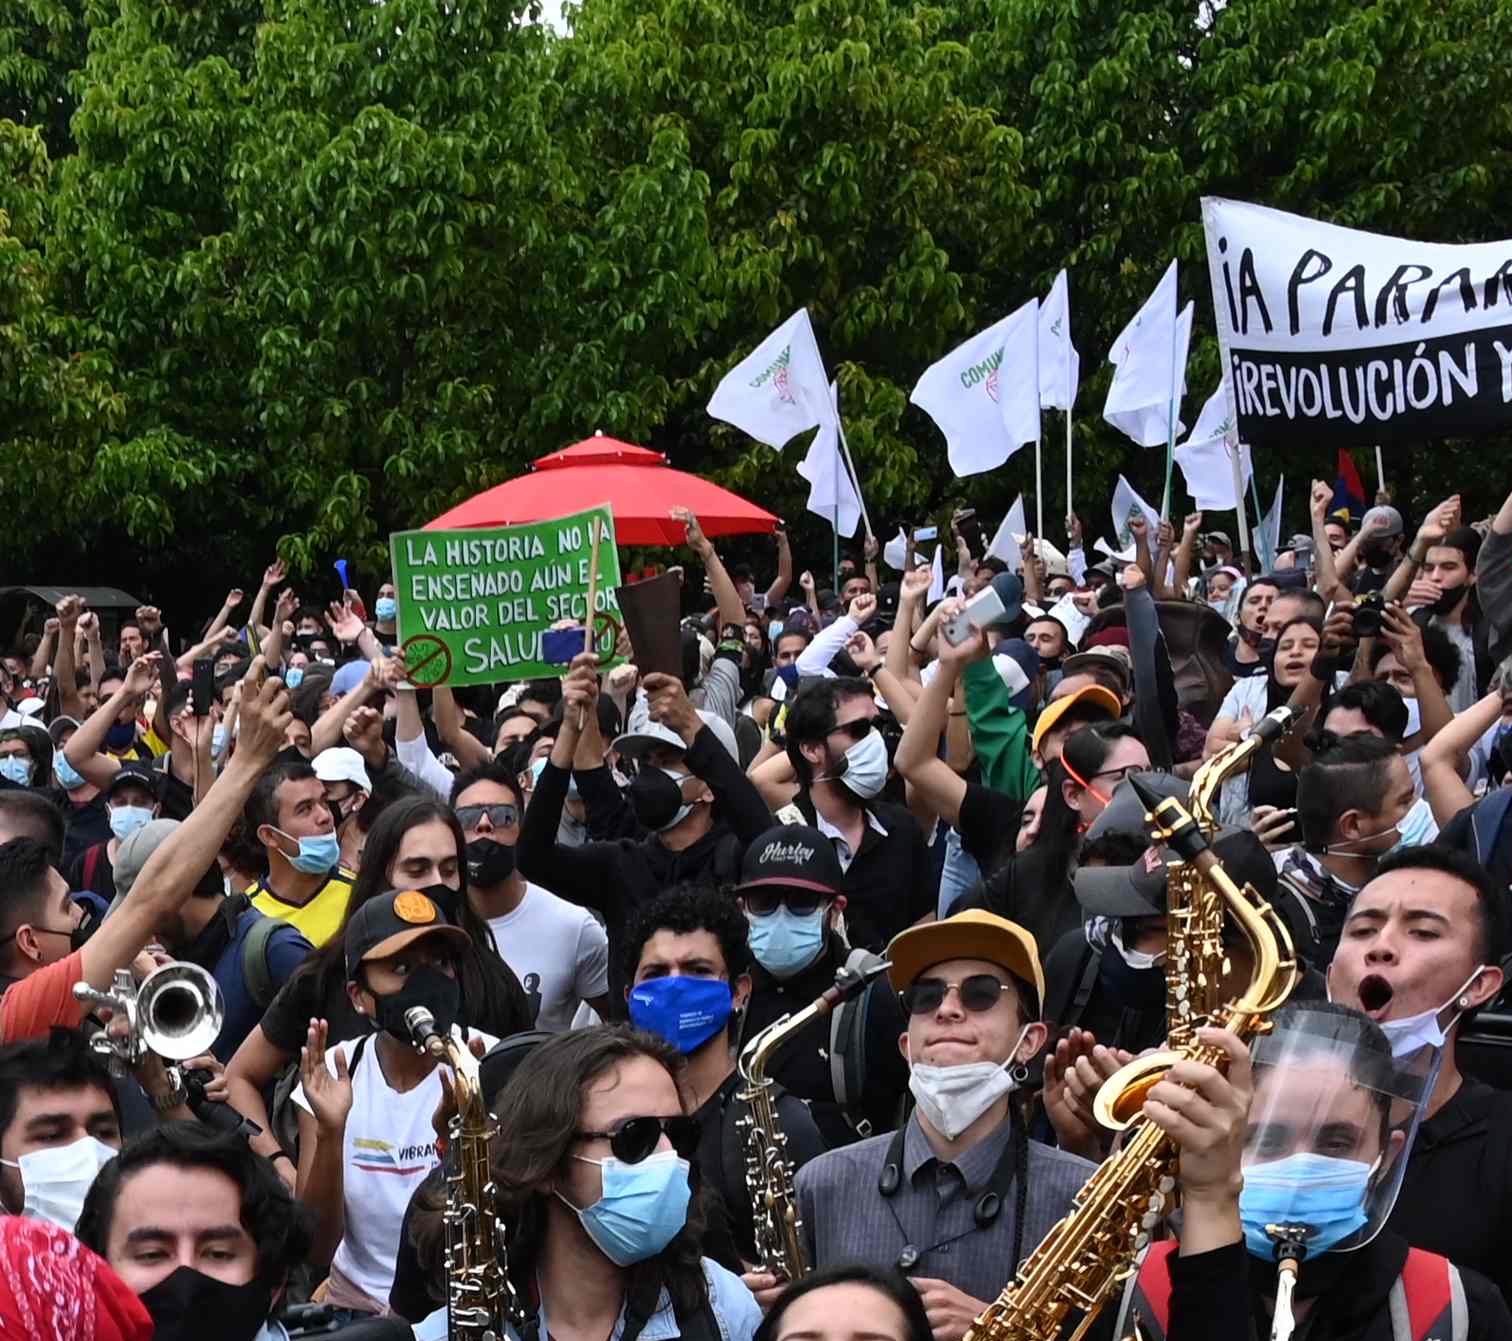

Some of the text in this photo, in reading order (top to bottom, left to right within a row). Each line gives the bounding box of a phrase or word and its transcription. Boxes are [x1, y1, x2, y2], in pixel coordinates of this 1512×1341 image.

[1232, 340, 1479, 425] ¡REVOLUCIÓN
[406, 538, 438, 568] LA
[445, 534, 545, 568] HISTORIA
[558, 527, 583, 553] NO
[410, 567, 524, 602] ENSEÑADO
[530, 558, 572, 592] AÚN
[419, 604, 491, 632] VALOR
[498, 600, 540, 627] DEL
